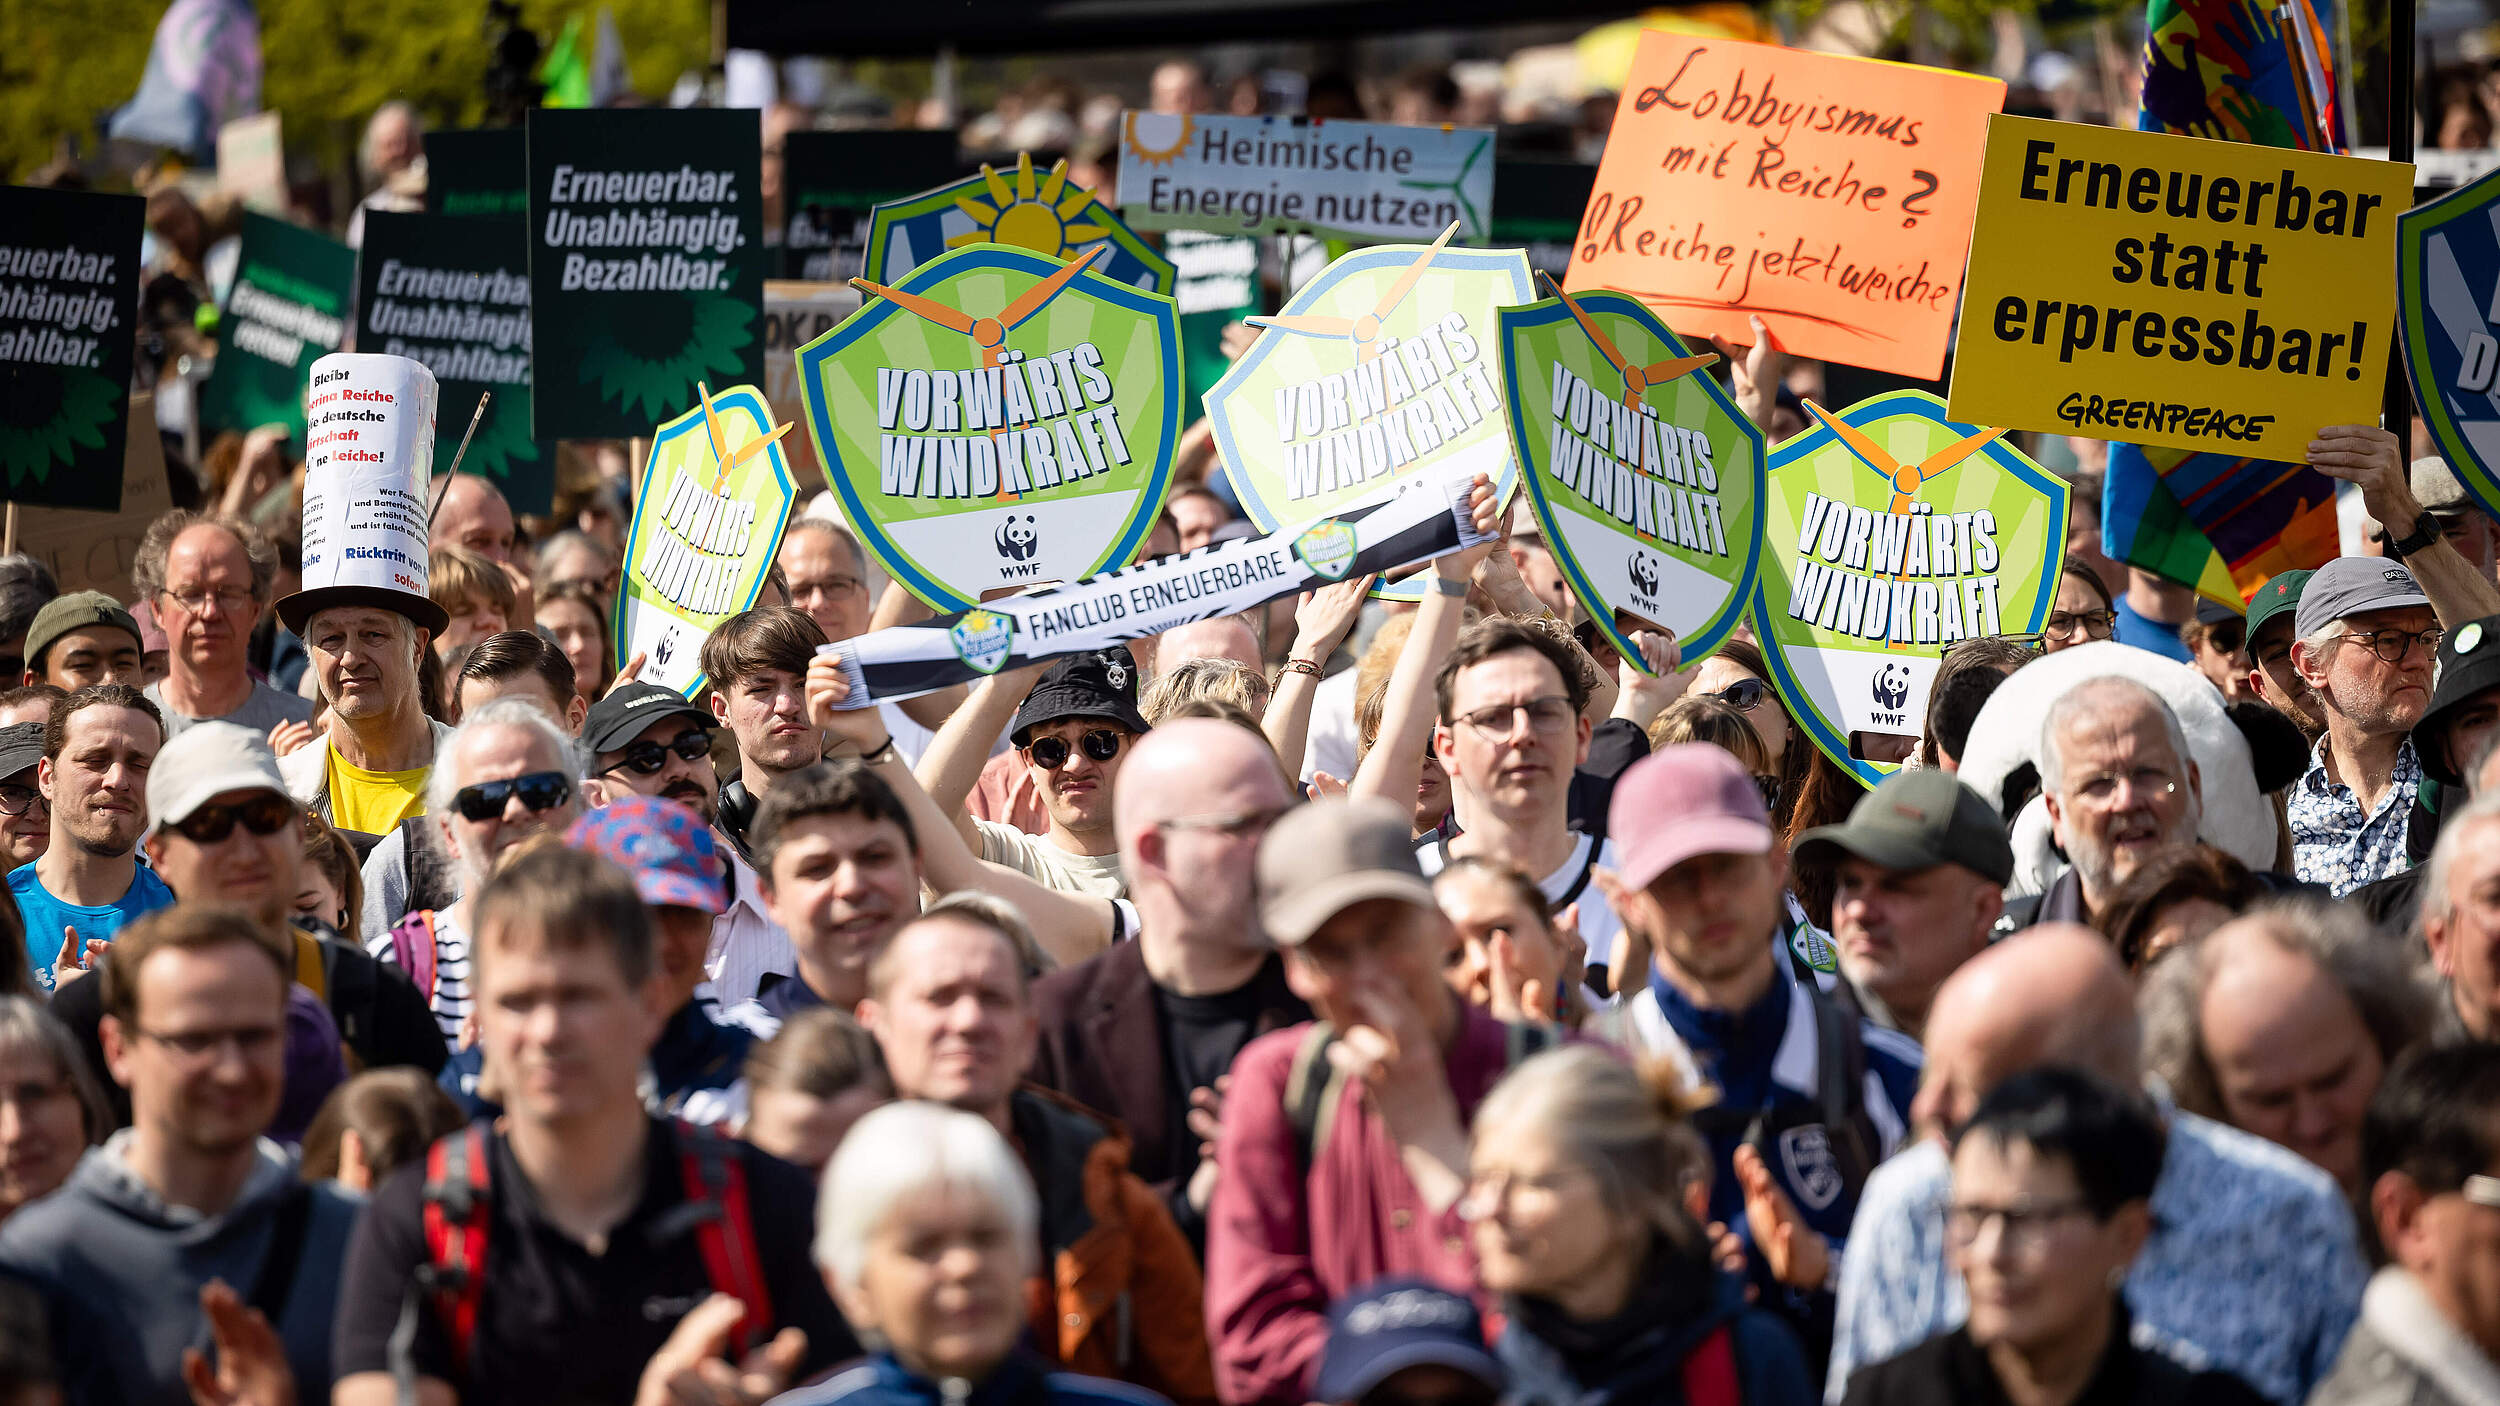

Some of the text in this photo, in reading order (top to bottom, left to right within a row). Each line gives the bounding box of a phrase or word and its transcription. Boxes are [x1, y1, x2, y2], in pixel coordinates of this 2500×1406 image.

[1635, 47, 1923, 147] Lobbyismus
[1202, 128, 1413, 174] Heimische
[1661, 140, 1737, 179] mit
[549, 164, 738, 203] Erneuerbar.
[1149, 176, 1304, 228] Energie
[1316, 192, 1458, 228] nutzen
[2019, 139, 2382, 239] Erneuerbar
[544, 207, 746, 254] Unabhängig.
[561, 252, 730, 291] Bezahlbar.
[2112, 231, 2268, 298] statt
[1993, 294, 2368, 382] erpressbar!
[314, 369, 350, 388] Bleibt
[877, 342, 1114, 431] VORWÄRTS
[1274, 311, 1480, 443] VORWÄRTS
[322, 409, 386, 424] deutsche
[1282, 361, 1502, 502] WINDKRAFT
[1551, 359, 1719, 494] VORWÄRTS
[2056, 391, 2275, 442] GREENPEACE
[332, 449, 385, 463] Leiche!
[880, 403, 1133, 498] WINDKRAFT
[354, 499, 371, 507] und
[379, 488, 397, 496] Wer
[661, 464, 756, 557] VORWÄRTS
[1549, 419, 1729, 558] WINDKRAFT
[350, 522, 367, 530] und
[370, 521, 380, 529] ist
[383, 522, 406, 533] falsch
[374, 511, 402, 520] erhöht
[1797, 491, 2000, 578] VORWÄRTS
[345, 546, 406, 564] Rücktritt
[640, 520, 743, 615] WINDKRAFT
[1000, 563, 1041, 579] WWF
[1029, 551, 1286, 640] FANCLUB ERNEUERBARE
[1630, 593, 1660, 616] WWF
[1788, 556, 2002, 645] WINDKRAFT
[1870, 712, 1906, 727] WWF
